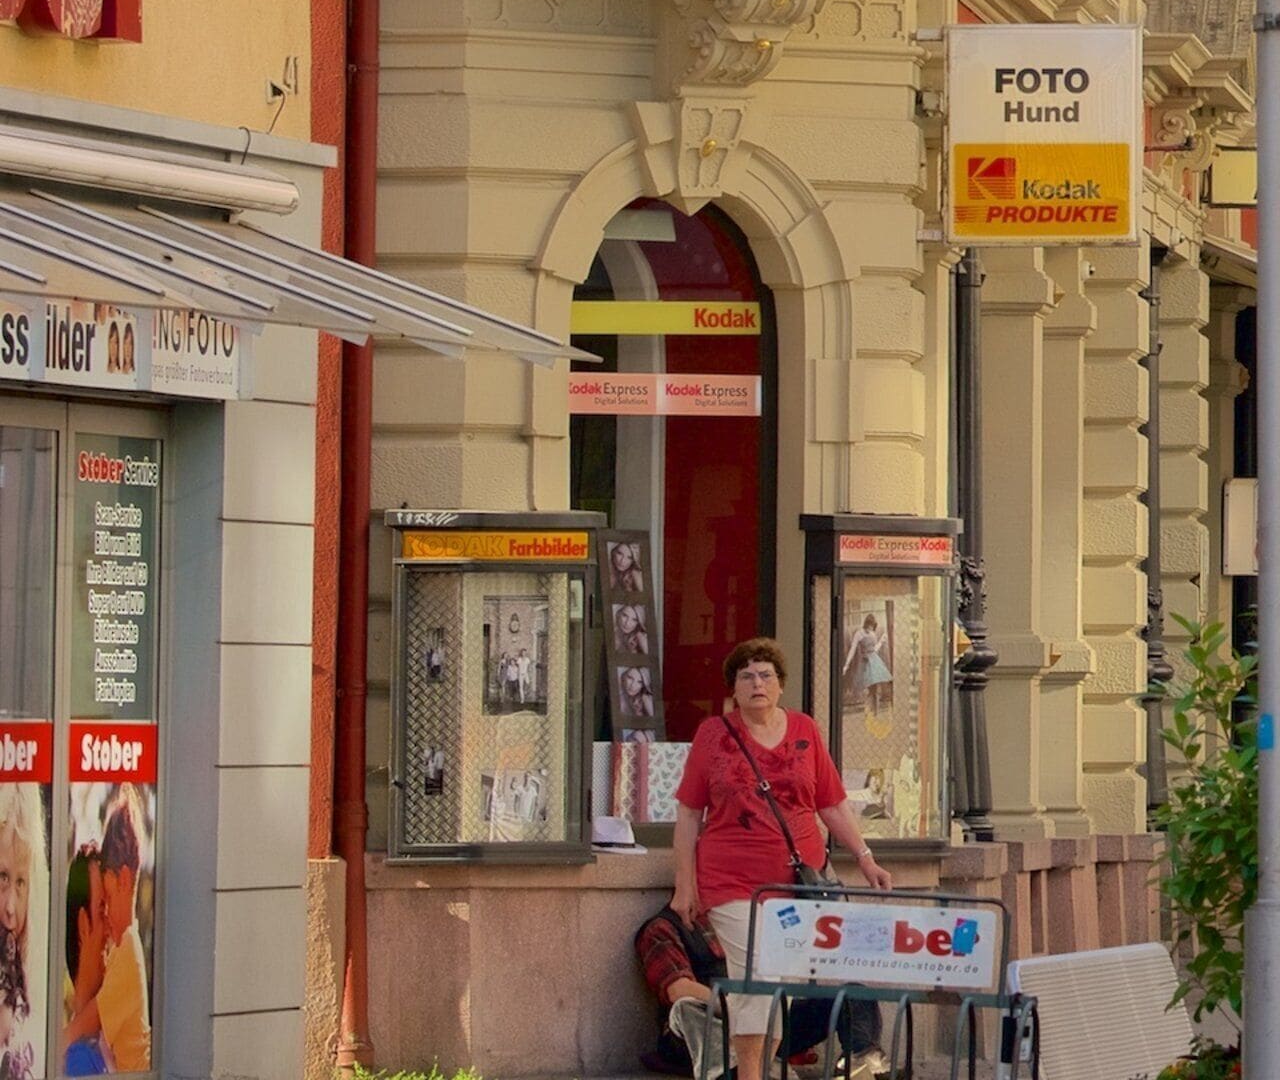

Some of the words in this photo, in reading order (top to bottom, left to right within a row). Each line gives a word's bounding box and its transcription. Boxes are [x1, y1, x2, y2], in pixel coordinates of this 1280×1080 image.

[995, 68, 1090, 94] FOTO
[1004, 101, 1080, 123] Hund
[1023, 179, 1101, 200] Kodak
[986, 206, 1119, 223] PRODUKTE
[694, 308, 756, 328] Kodak
[603, 382, 648, 397] Express
[665, 384, 700, 396] Kodak
[703, 384, 748, 399] Express
[594, 397, 617, 406] Digital
[618, 397, 648, 406] Solutions
[695, 399, 716, 407] Digital
[718, 399, 748, 407] Solutions
[79, 451, 123, 483] Stober
[124, 455, 159, 487] Service
[95, 501, 142, 528] Scan-Service
[95, 531, 110, 556] Bild
[110, 536, 125, 556] vom
[126, 532, 141, 557] Bild
[404, 535, 505, 557] KODAK
[509, 537, 587, 557] Farbbilder
[841, 538, 875, 550] Kodak
[878, 539, 919, 553] Express
[86, 560, 101, 584] Ihre
[102, 561, 123, 585] Bilder
[88, 589, 109, 618] Super
[117, 591, 130, 615] auf
[129, 591, 145, 616] DVD
[94, 619, 139, 644] Bildretusche
[94, 648, 138, 674] Ausschnitte
[95, 678, 136, 707] Farbkopien
[81, 733, 143, 771] Stober
[809, 955, 979, 974] www.fotostudio-stober.de
